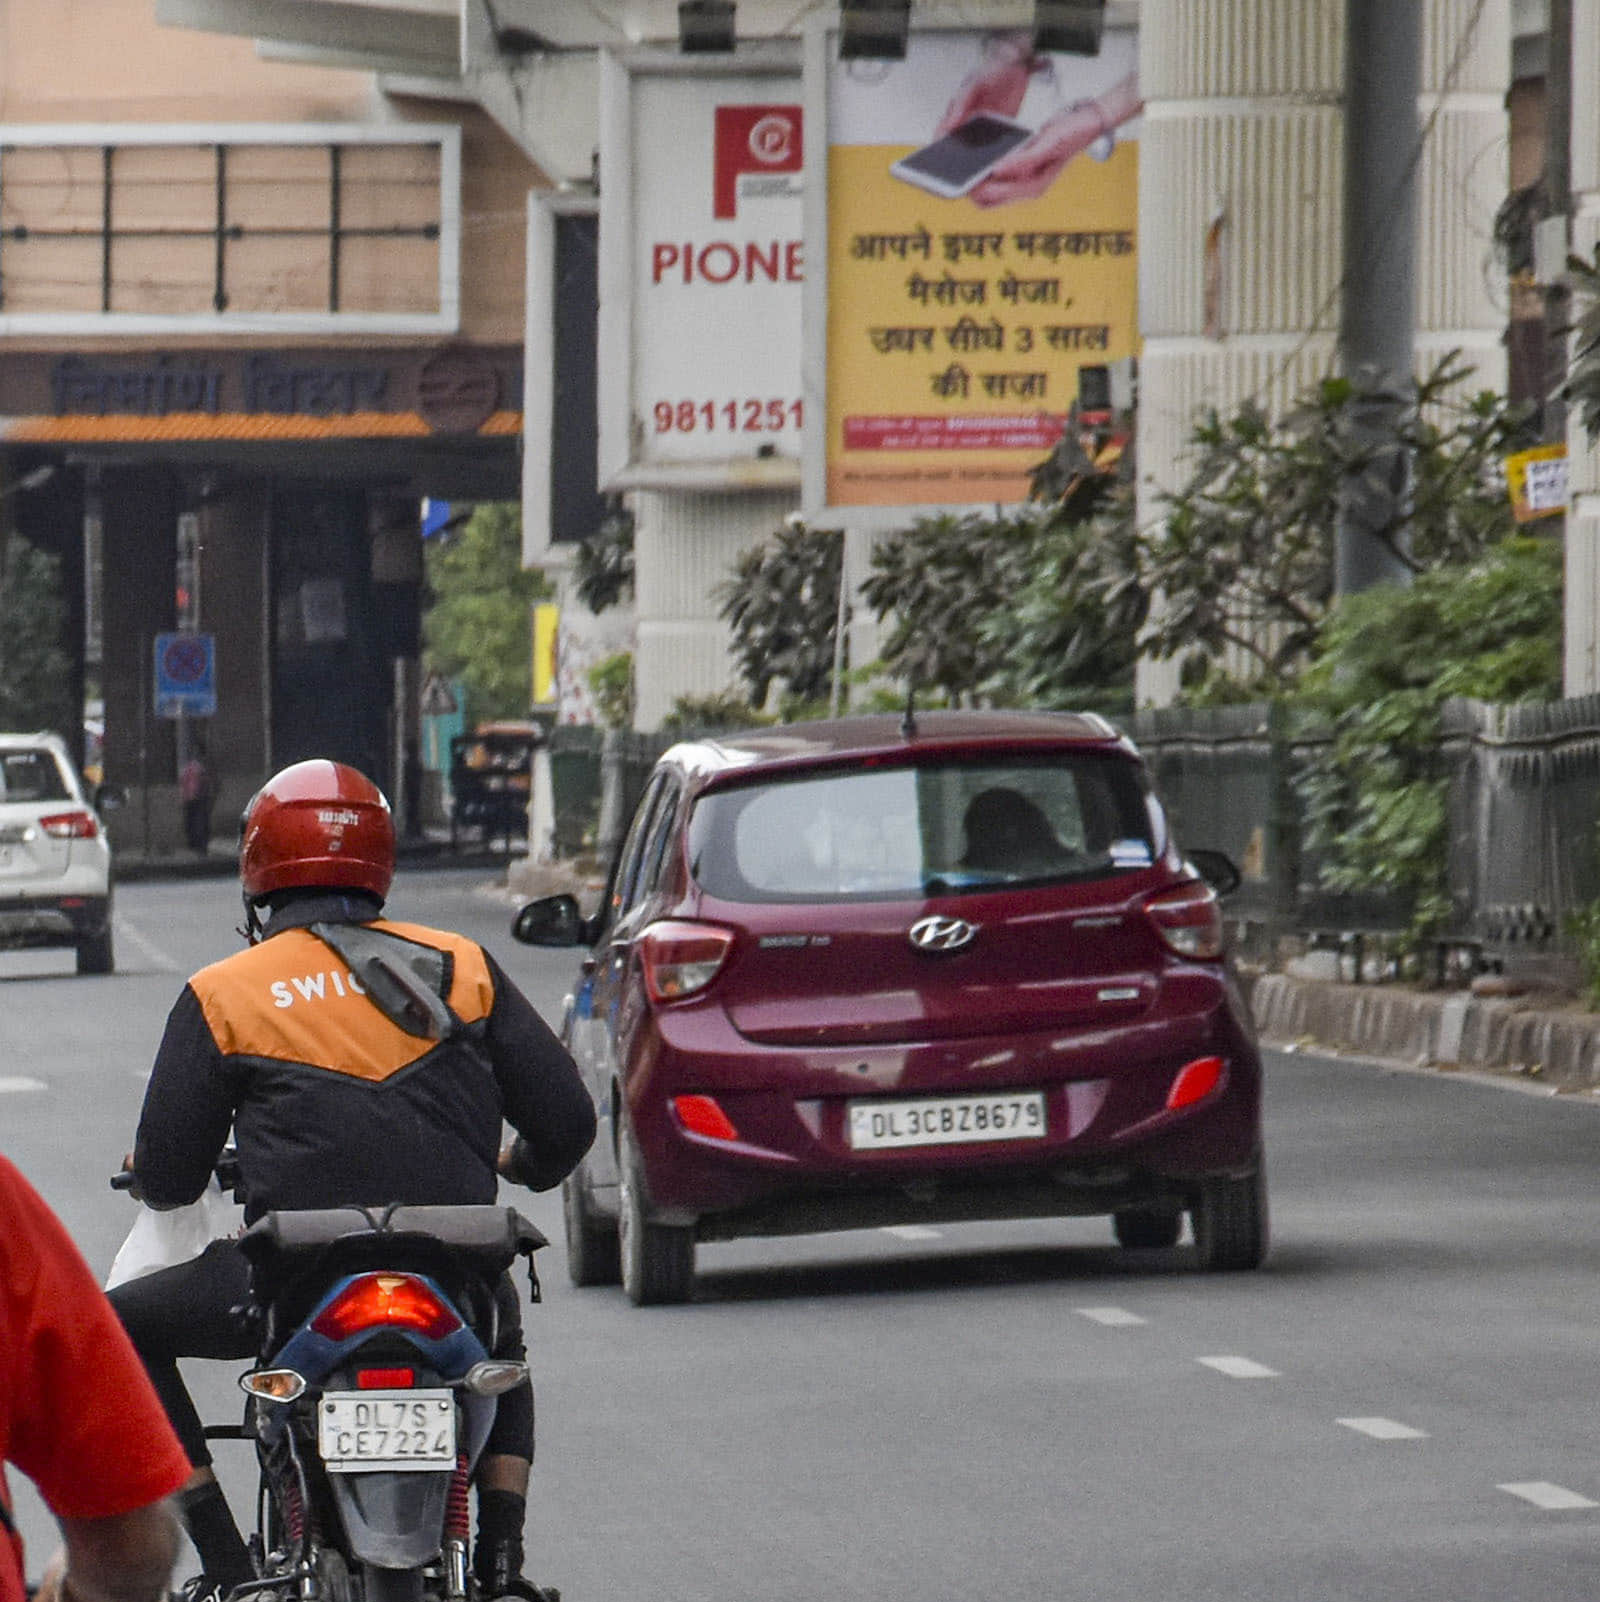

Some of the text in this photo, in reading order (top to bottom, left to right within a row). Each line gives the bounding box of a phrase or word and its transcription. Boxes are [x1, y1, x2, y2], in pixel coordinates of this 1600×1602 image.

[853, 222, 932, 260] आपने
[943, 231, 1004, 262] इधर
[869, 326, 934, 353] उधर
[1015, 326, 1033, 351] 3
[1045, 325, 1108, 352] साल
[932, 362, 970, 399] की
[653, 399, 804, 433] 9811251
[872, 1103, 1041, 1137] DL3CBZ8679
